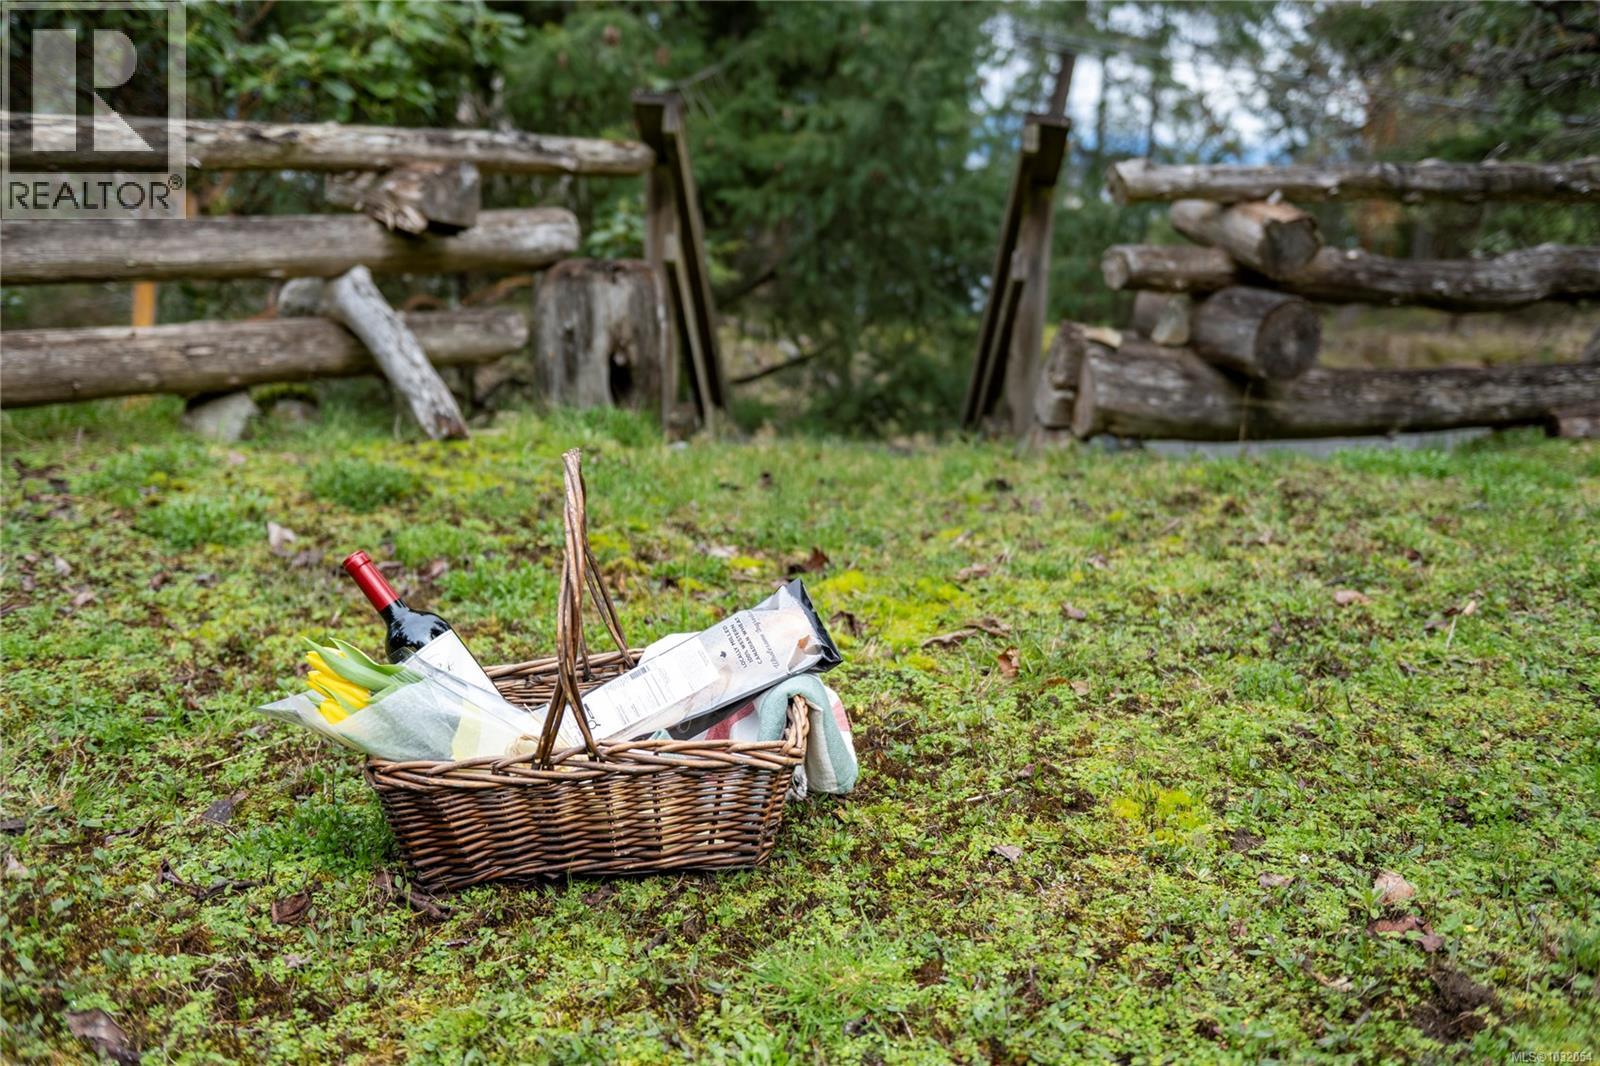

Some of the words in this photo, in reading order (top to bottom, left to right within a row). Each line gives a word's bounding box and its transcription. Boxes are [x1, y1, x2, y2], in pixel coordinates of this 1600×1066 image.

[722, 625, 736, 646] MILLED
[734, 616, 747, 636] WHEAT
[730, 624, 746, 650] WESTERN
[733, 647, 748, 669] LOCALLY
[744, 649, 754, 663] 100%
[745, 636, 763, 665] CANADIAN
